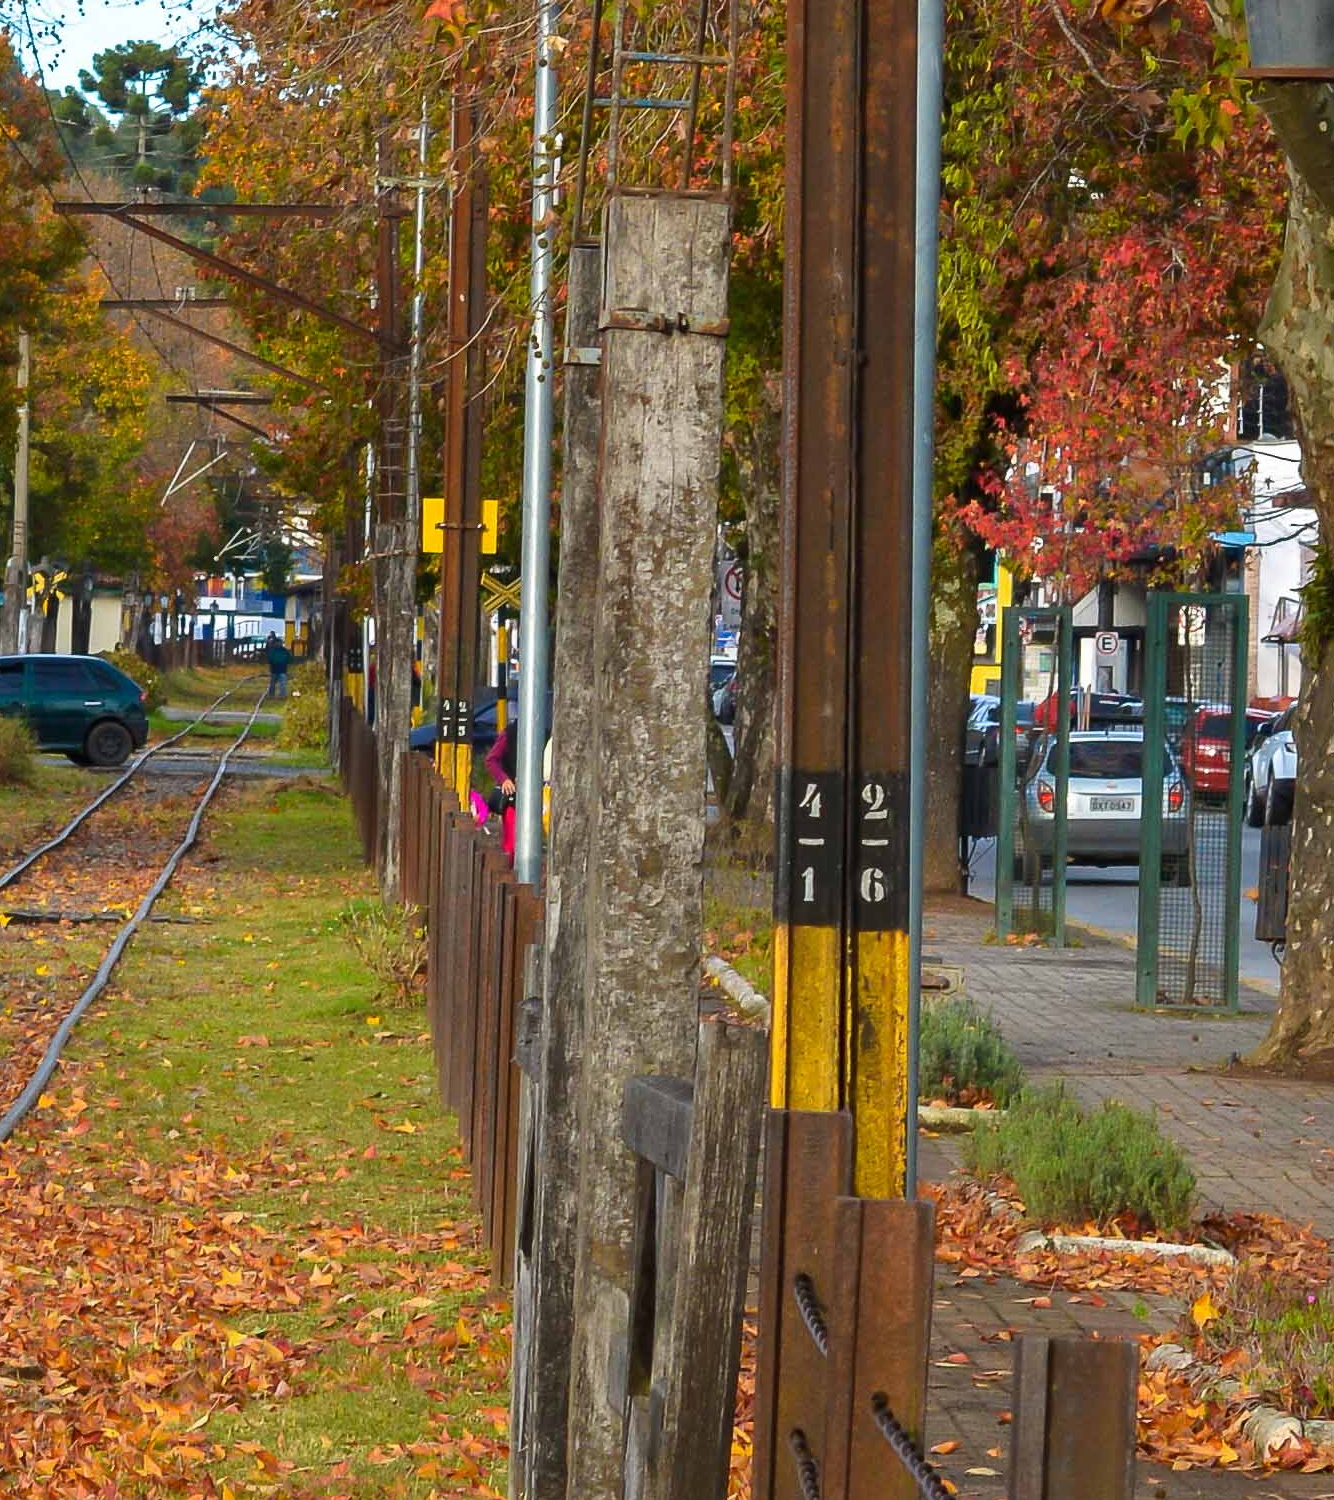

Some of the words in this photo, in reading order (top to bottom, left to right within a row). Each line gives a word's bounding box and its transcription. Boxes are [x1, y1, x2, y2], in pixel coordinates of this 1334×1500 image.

[1102, 636, 1113, 650] E
[861, 783, 889, 820] 2
[801, 866, 815, 902] 1
[860, 867, 885, 902] 6
